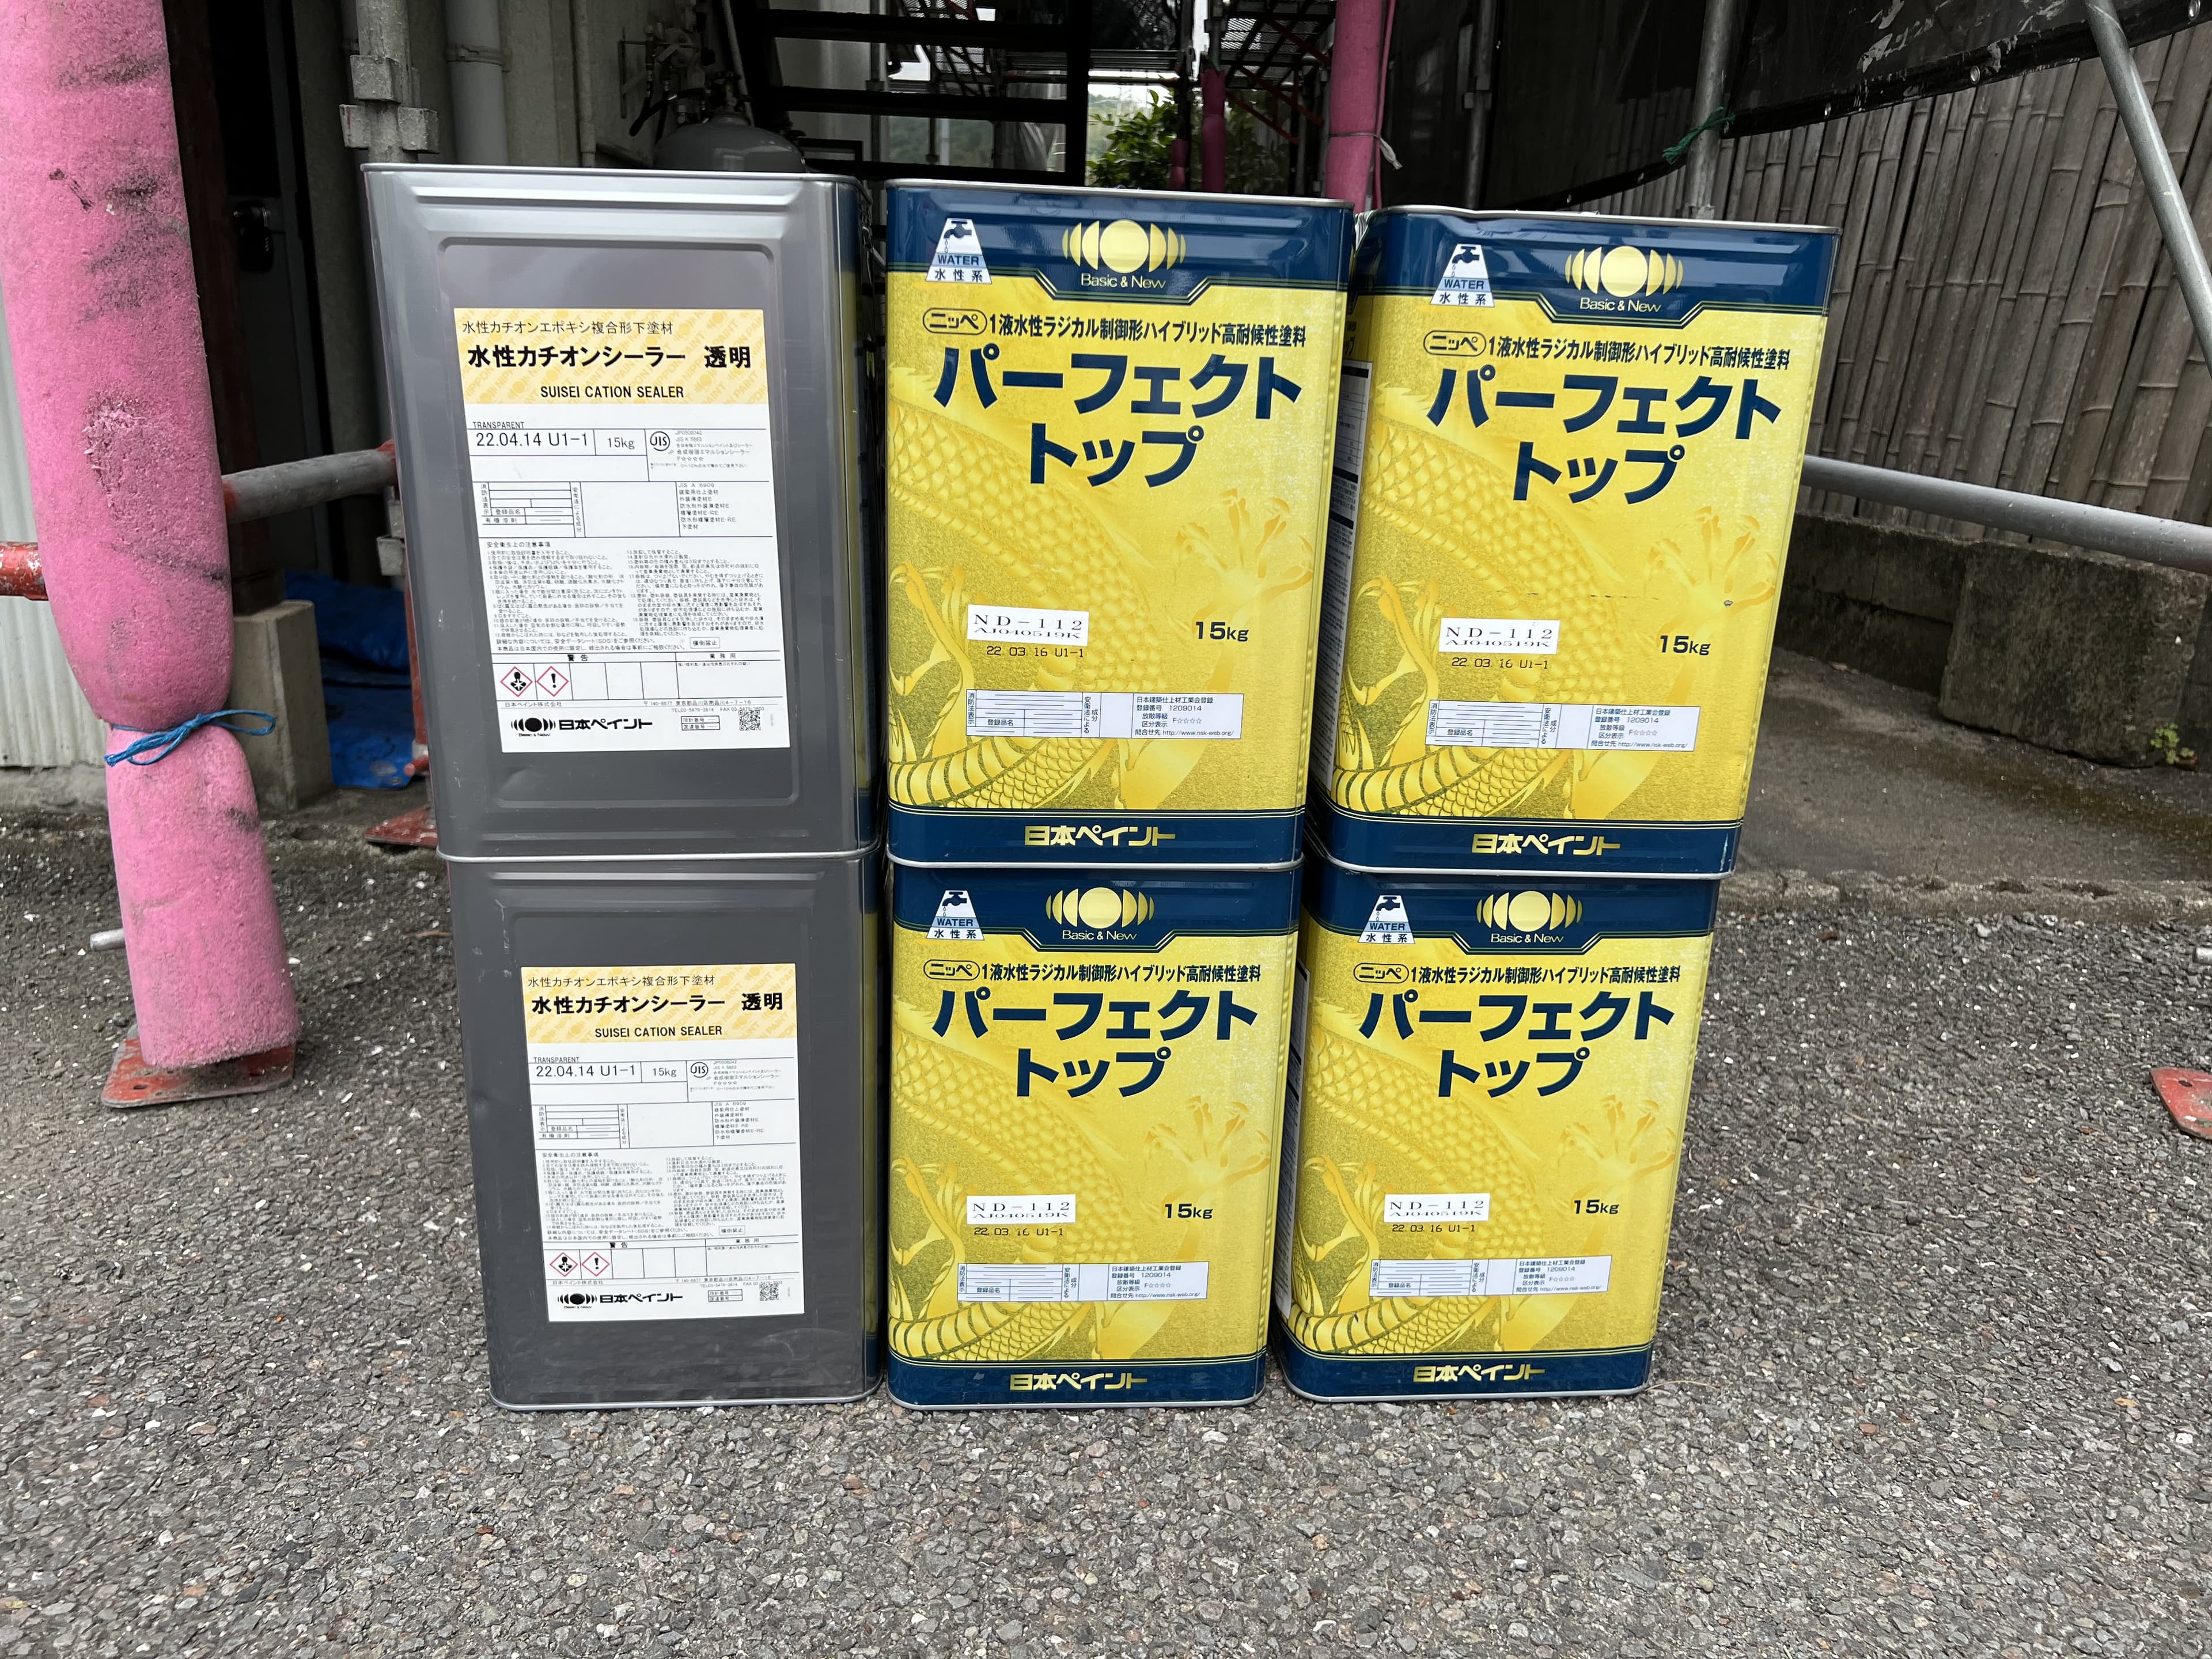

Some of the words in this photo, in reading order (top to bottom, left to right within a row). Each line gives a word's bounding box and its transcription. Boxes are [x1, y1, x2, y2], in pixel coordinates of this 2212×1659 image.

[937, 255, 979, 266] WATER
[934, 268, 983, 283] 水性系
[1081, 273, 1118, 287] Basic
[1120, 275, 1129, 287] &
[1132, 275, 1166, 290] New
[1443, 278, 1484, 291] WATER
[1439, 291, 1487, 306] 水性系
[1580, 297, 1616, 312] Basic
[1617, 301, 1626, 312] &
[1628, 300, 1662, 314] New
[462, 320, 673, 335] 水性カチオンエポキシ複合形下塗材
[929, 313, 979, 330] ニッペ
[990, 314, 1306, 348] 1液水性ラジカル制御形ハイブリッド高耐候性塗料
[468, 345, 686, 368] 水性カチオンシーラー
[704, 346, 751, 368] 透明
[1429, 335, 1478, 353] ニッペ
[1489, 337, 1790, 371] 1液水性ラジカル制御形ハイブリッド高耐候性塗料
[934, 343, 1302, 419] パーフェクト
[540, 386, 581, 398] SUISEI
[585, 385, 632, 398] CATION
[637, 385, 684, 398] SEALER
[1426, 364, 1782, 440] パーフェクト
[473, 421, 525, 429] TRANSPARENT
[476, 433, 542, 447] 22.04.14
[548, 433, 589, 446] U1-1
[607, 437, 635, 450] 15kg
[1031, 423, 1204, 487] トップ
[1513, 441, 1685, 505] トップ
[1196, 621, 1249, 642] 15kg
[1055, 647, 1084, 657] U1-1
[1659, 635, 1711, 656] 15kg
[1520, 659, 1548, 669] U1-1
[559, 718, 653, 730] 日本ペイント
[1024, 825, 1176, 847] 日本ペイント
[1471, 833, 1621, 856] 日本ペイント
[937, 917, 974, 928] WATER
[1369, 921, 1405, 931] WATER
[934, 929, 977, 940] 水性系
[1062, 930, 1094, 941] Basic
[1097, 931, 1104, 941] &
[1106, 930, 1137, 941] New
[1365, 933, 1408, 943] 水性系
[1491, 933, 1522, 944] Basic
[1524, 934, 1531, 944] &
[1533, 933, 1565, 944] New
[929, 963, 973, 978] ニッペ
[982, 964, 1261, 983] 1液水性ラジカル制御形ハイブリッド高耐候性塗料
[1358, 966, 1403, 981] ニッペ
[1412, 965, 1680, 984] 1液水性ラジカル制御形ハイブリッド高耐候性塗料
[528, 975, 715, 987] 水性カチオンエポキシ複合形下塗材
[532, 995, 725, 1014] 水性カチオンシーラー
[741, 993, 783, 1010] 透明
[931, 986, 1257, 1041] パーフェクト
[1358, 989, 1675, 1042] パーフェクト
[595, 1028, 630, 1037] SUISEI
[634, 1027, 676, 1037] CATION
[680, 1025, 722, 1036] SEALER
[536, 1066, 594, 1077] 22.04.14
[601, 1065, 635, 1076] U1-1
[653, 1067, 677, 1077] 15kg
[1017, 1046, 1171, 1097] トップ
[1438, 1047, 1590, 1098] トップ
[1164, 1203, 1213, 1219] 15kg
[1573, 1199, 1619, 1214] 15kg
[600, 1293, 683, 1303] 日本ペイント
[1413, 1365, 1546, 1382] 日本ペイント
[1010, 1373, 1147, 1391] 日本ペイント
